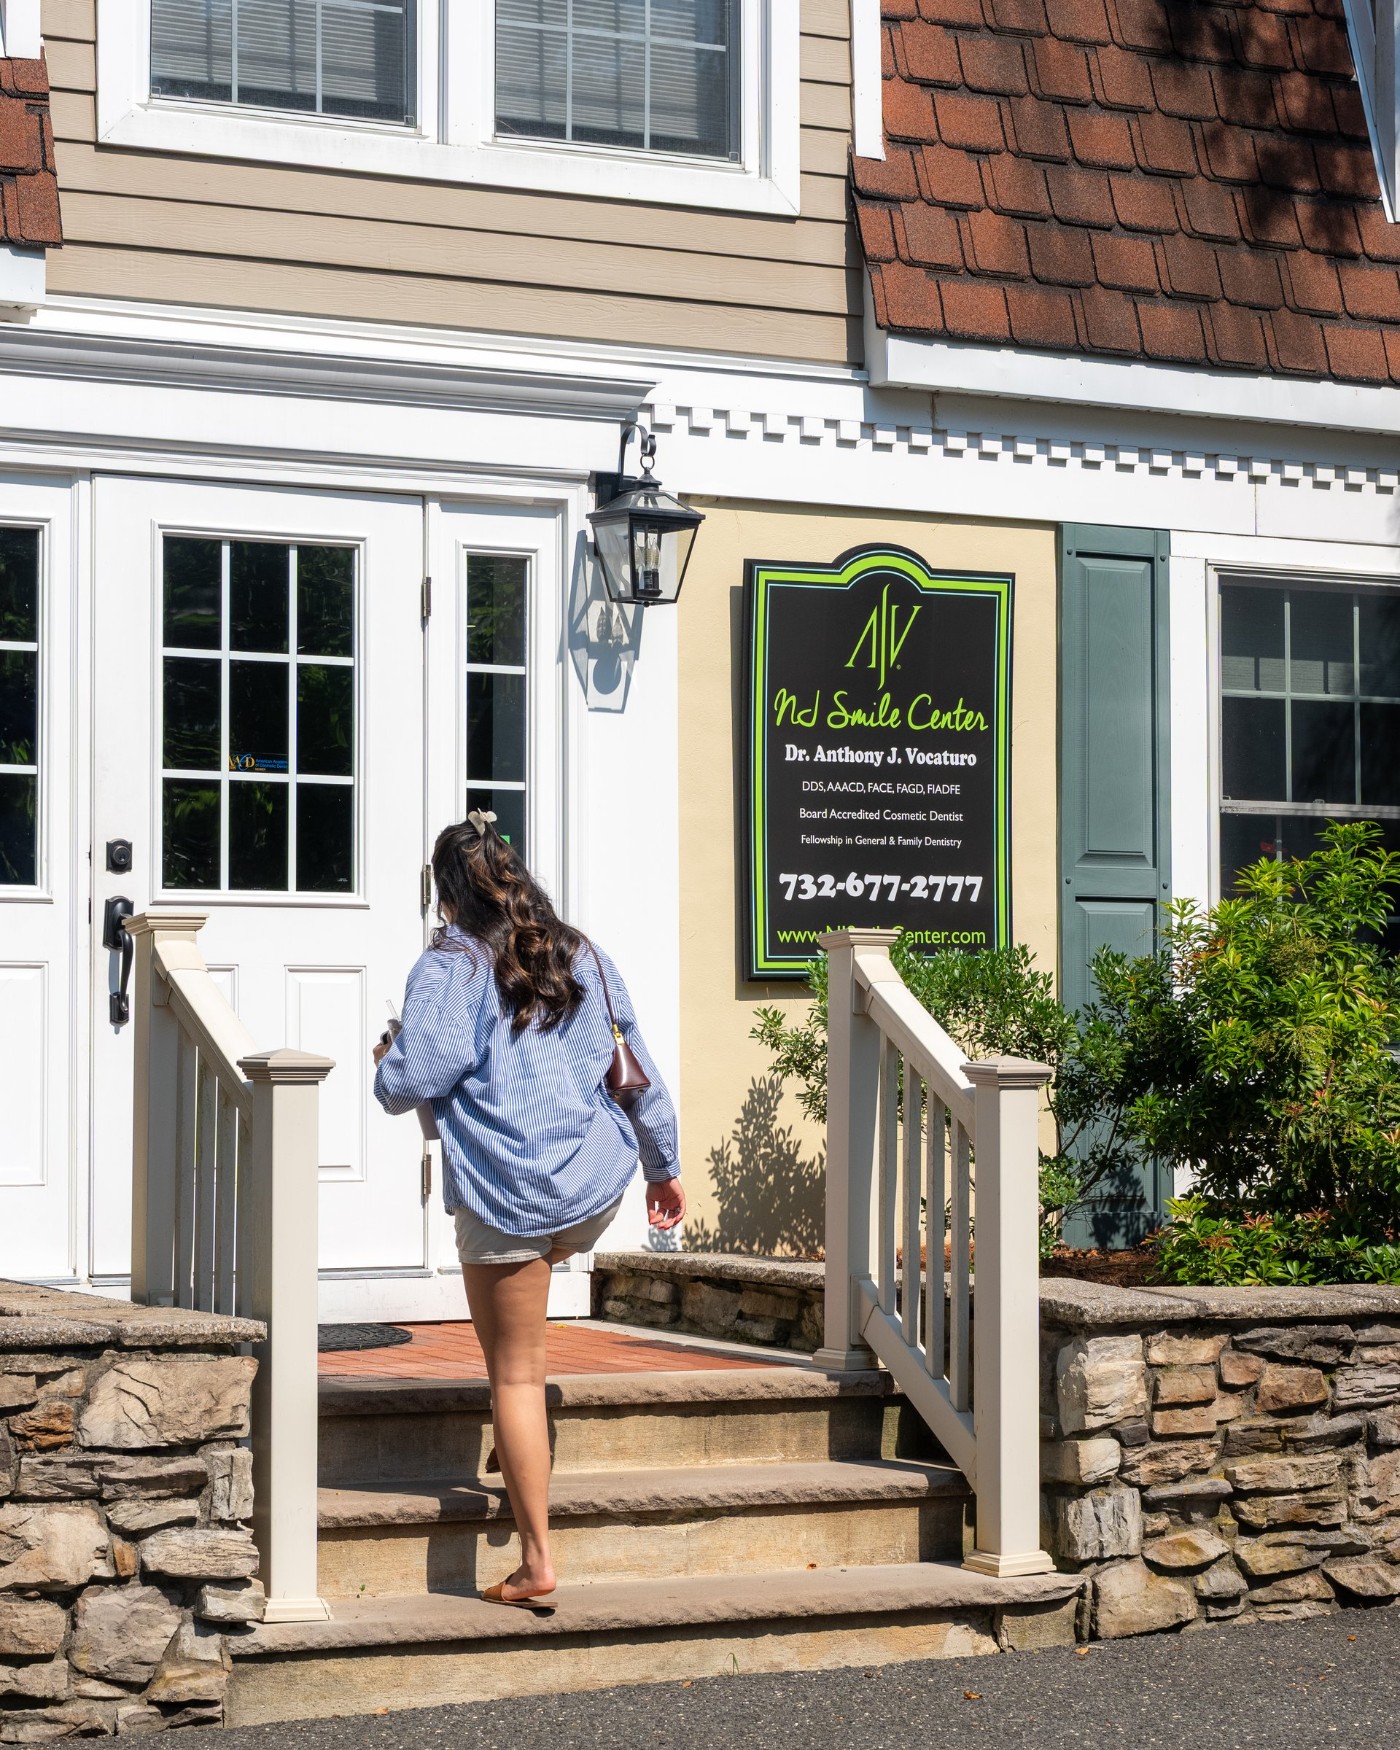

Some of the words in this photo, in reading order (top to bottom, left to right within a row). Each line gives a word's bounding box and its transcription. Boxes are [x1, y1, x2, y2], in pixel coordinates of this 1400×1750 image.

[827, 689, 901, 728] Smile
[908, 694, 988, 731] Center
[785, 744, 810, 761] Dr.
[813, 745, 884, 767] Anthony
[887, 747, 901, 764] J.
[905, 748, 976, 766] Vocaturo
[803, 781, 826, 792] DDS,
[827, 782, 866, 793] AAACD,
[868, 783, 894, 794] FACE,
[897, 784, 925, 794] FAGD,
[928, 784, 960, 794] FIADFE
[800, 808, 827, 818] Board
[829, 809, 880, 819] Accredited
[883, 810, 926, 820] Cosmetic
[930, 811, 963, 821] Dentist
[802, 835, 843, 846] Fellowship
[846, 836, 852, 844] in
[855, 836, 886, 845] General
[889, 836, 895, 845] &
[898, 836, 922, 848] Family
[925, 837, 961, 848] Dentistry
[779, 872, 983, 902] 732-677-2777
